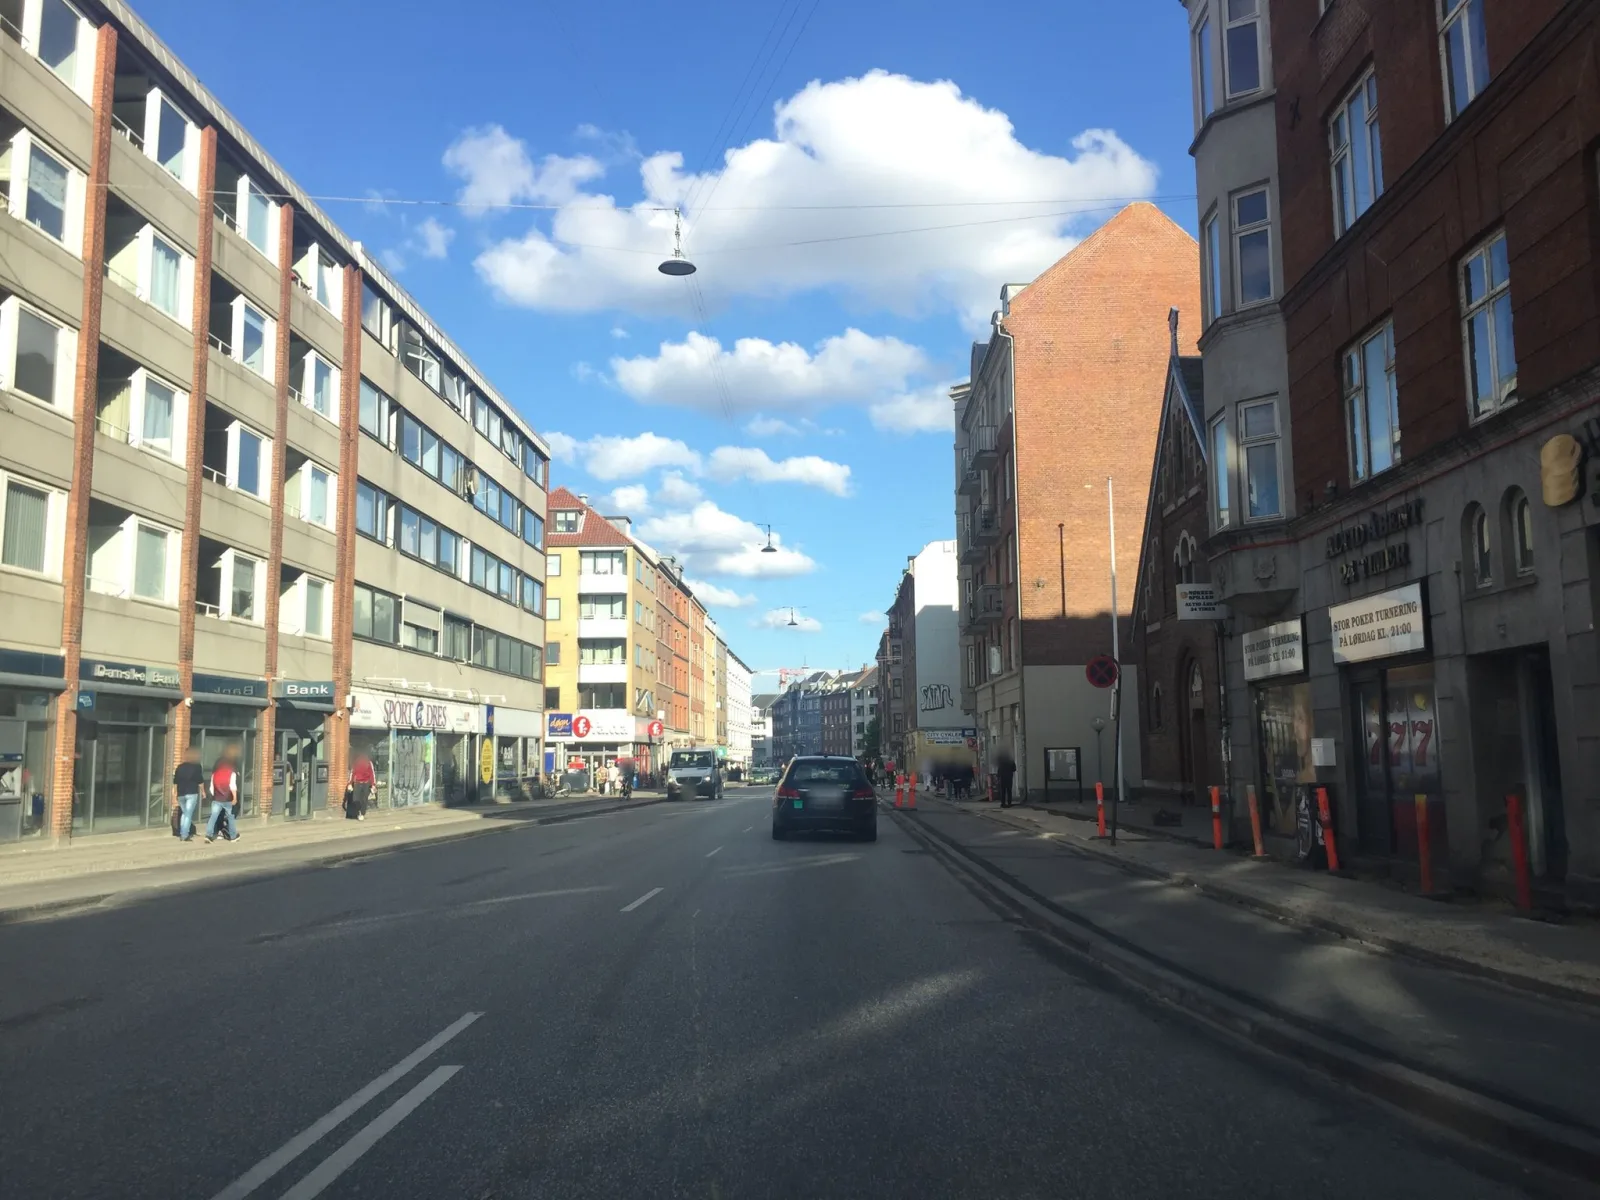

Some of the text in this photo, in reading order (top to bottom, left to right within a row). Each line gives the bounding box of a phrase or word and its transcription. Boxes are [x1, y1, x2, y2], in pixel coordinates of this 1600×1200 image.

[1333, 601, 1418, 632] STOR POKER TURNERING
[1339, 632, 1349, 648] PÅ
[1349, 629, 1376, 646] LØRDAG
[1391, 622, 1412, 637] 21:00
[94, 664, 146, 682] Danske
[286, 684, 329, 695] Bank
[383, 699, 414, 725] SPORT
[426, 705, 447, 728] DRES
